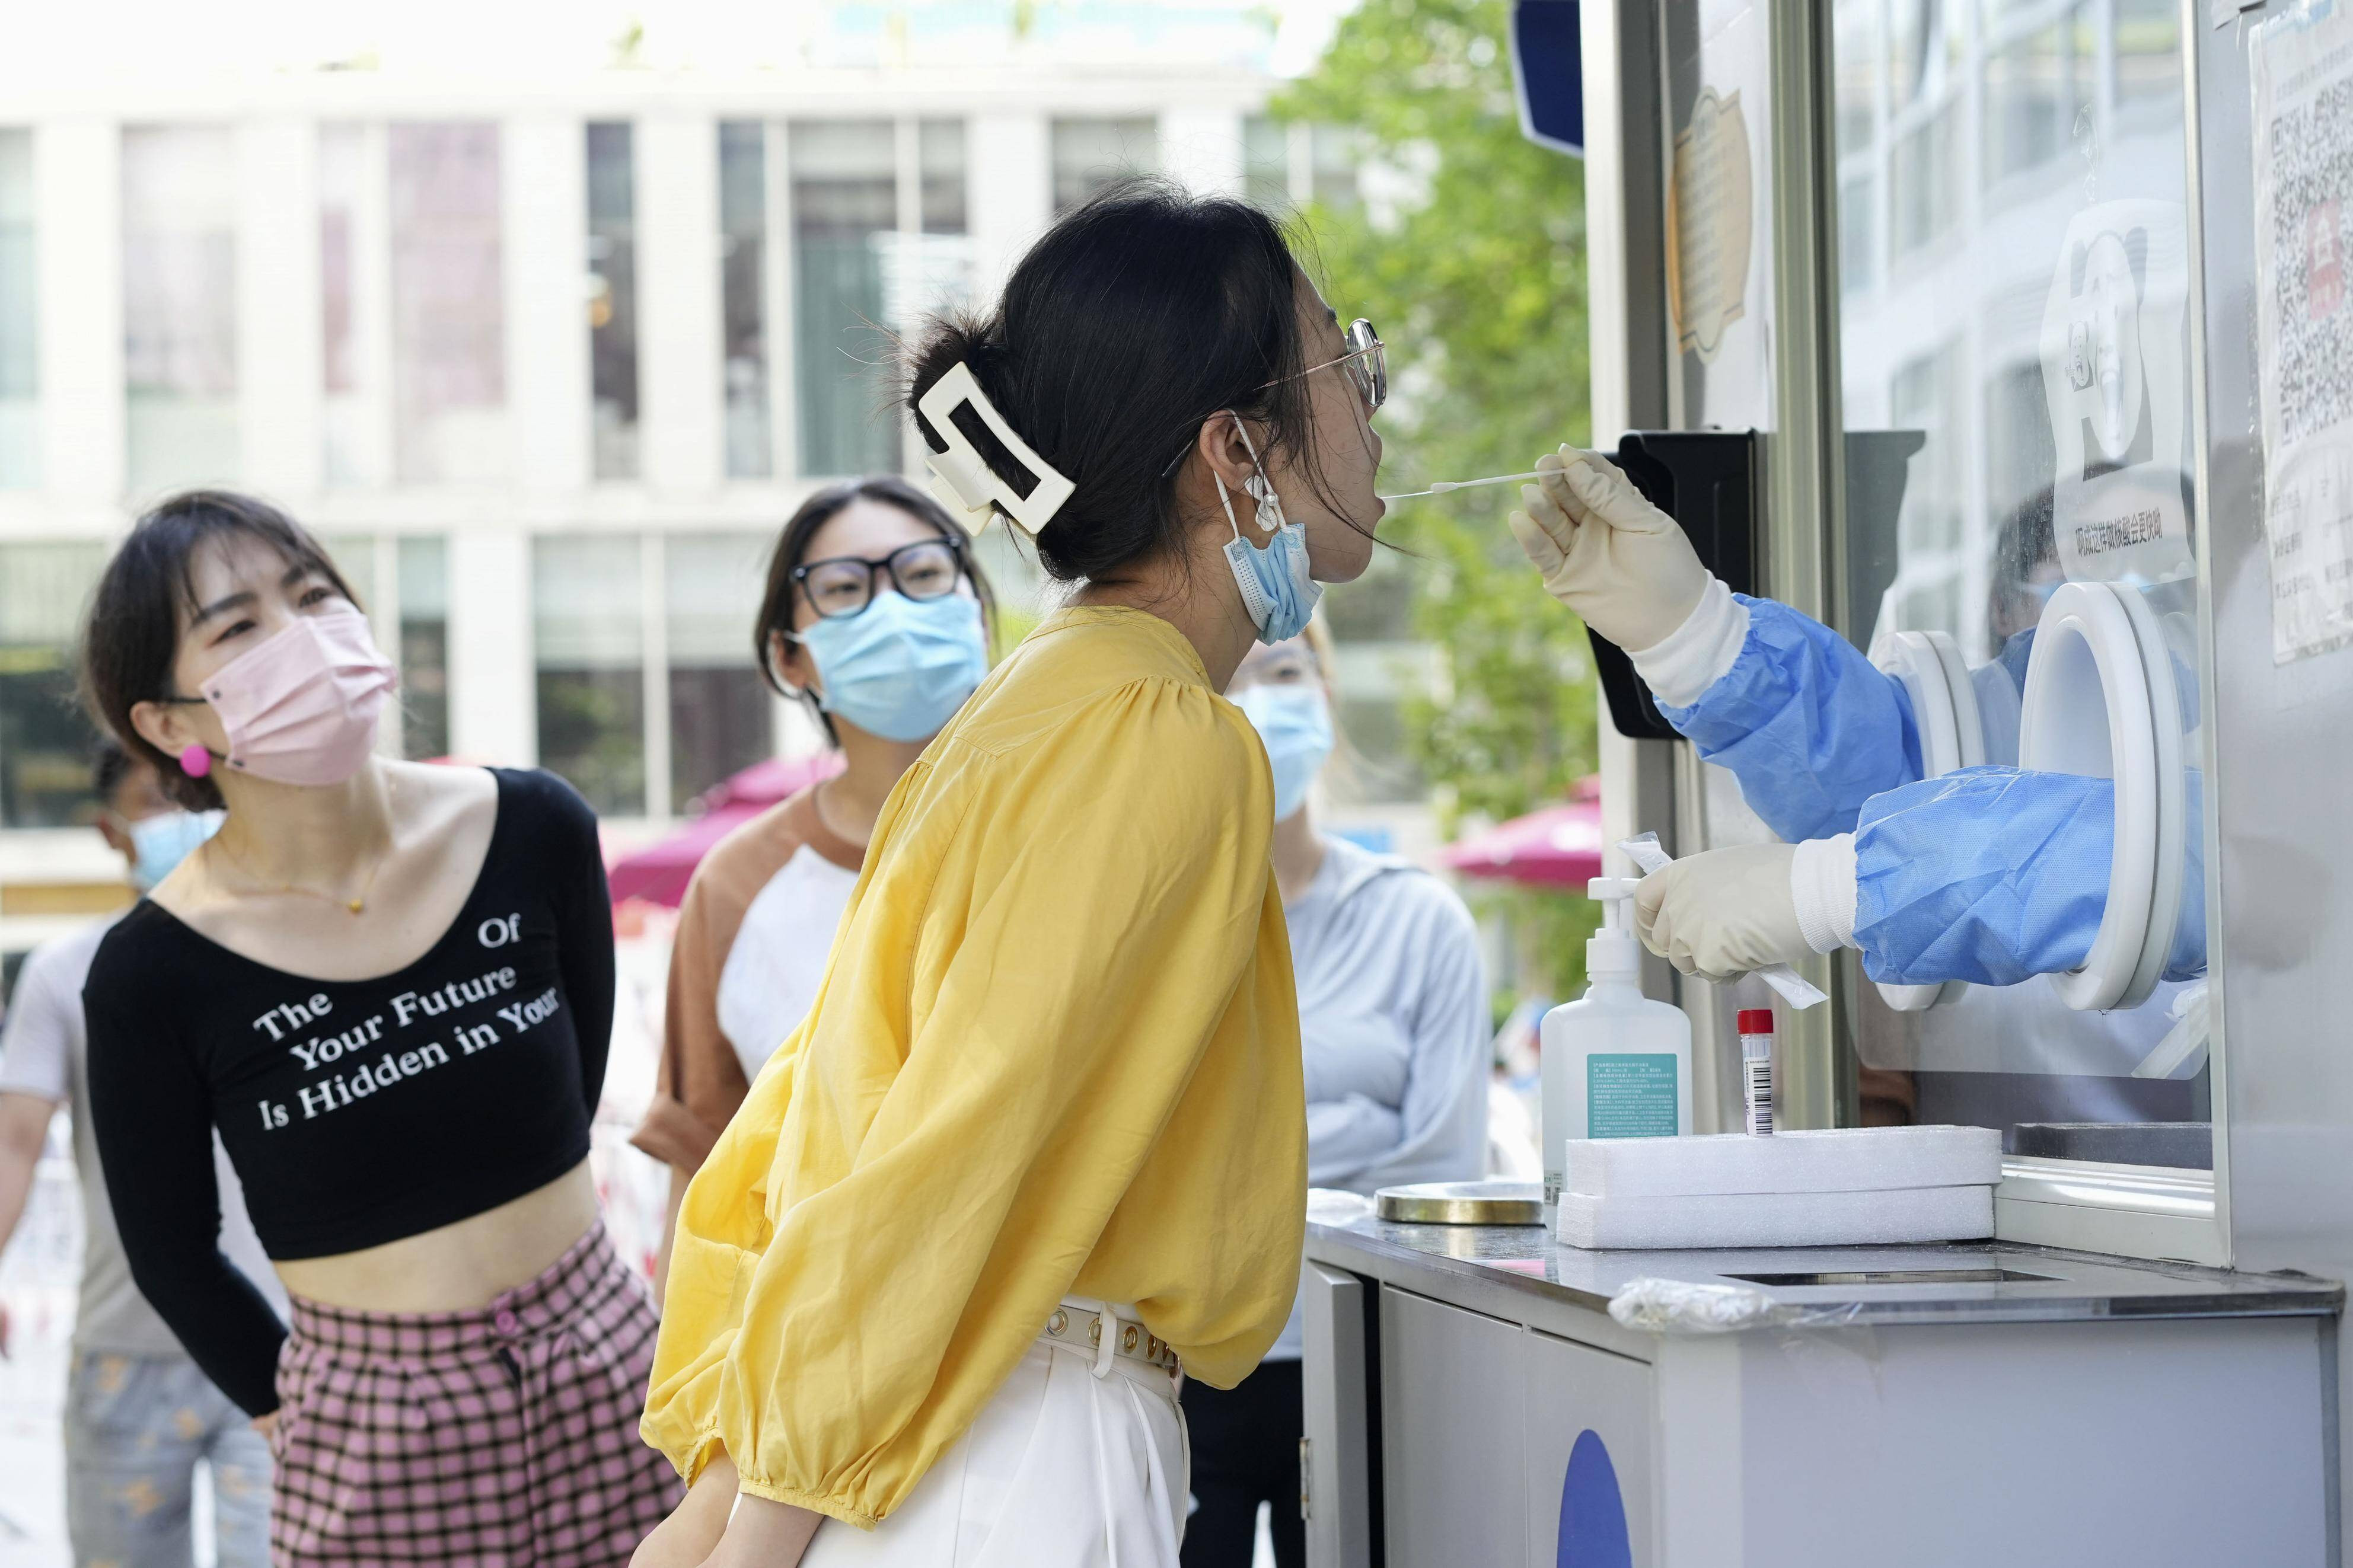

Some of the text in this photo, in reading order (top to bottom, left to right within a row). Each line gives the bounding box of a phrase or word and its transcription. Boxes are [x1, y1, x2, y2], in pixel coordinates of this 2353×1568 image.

[253, 913, 521, 1041] The Of
[290, 967, 516, 1071] Your Future
[259, 988, 559, 1130] Is Hidden in Your
